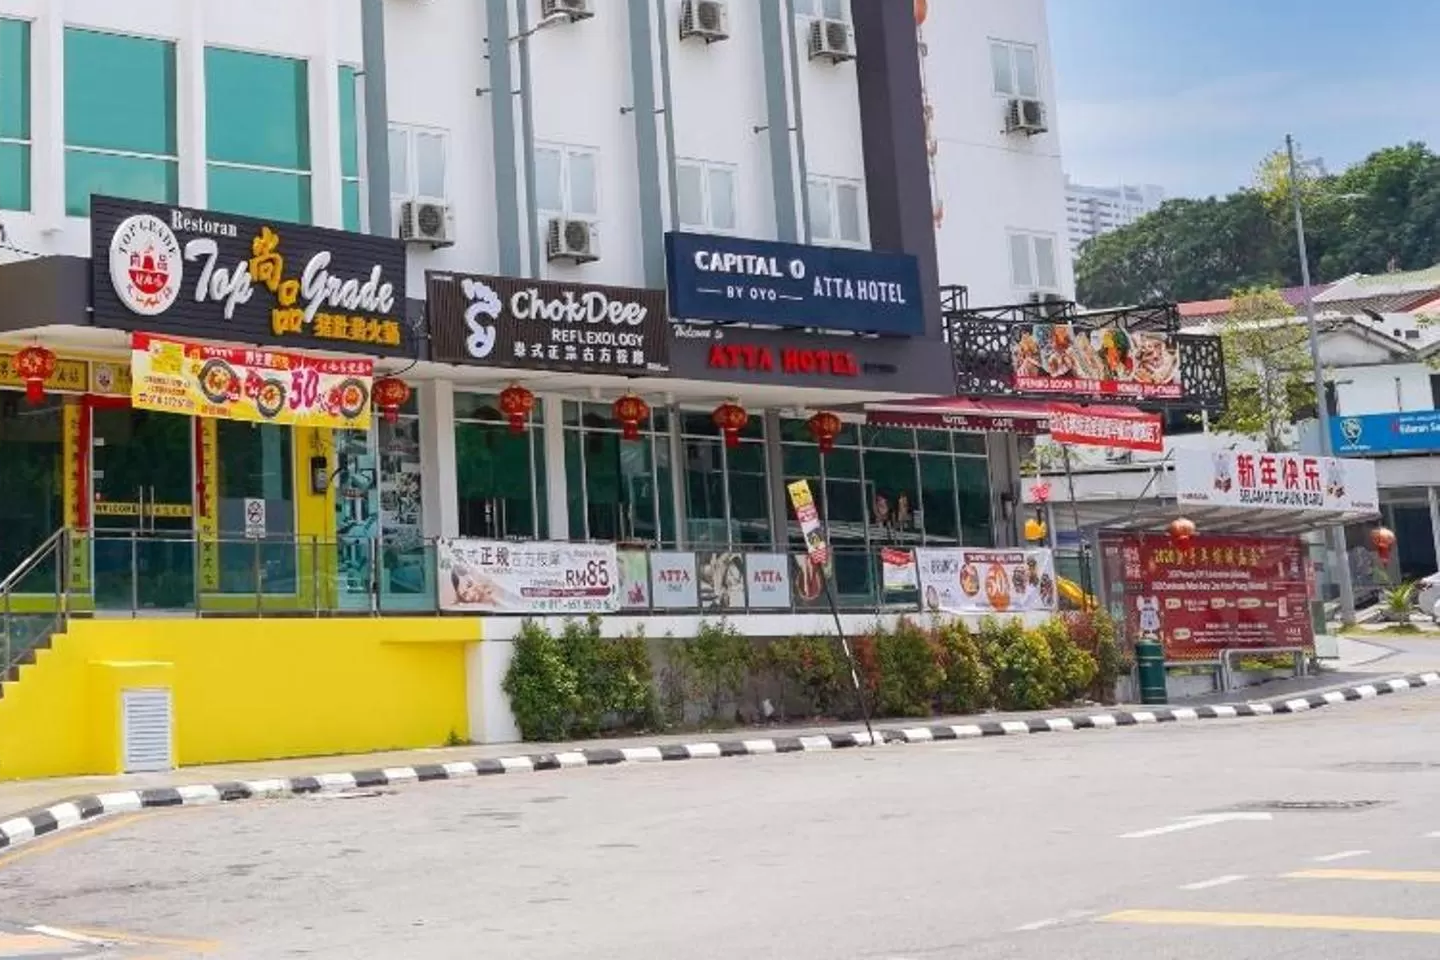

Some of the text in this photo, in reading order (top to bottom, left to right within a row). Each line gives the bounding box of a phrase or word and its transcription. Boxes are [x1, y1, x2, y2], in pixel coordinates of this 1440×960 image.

[171, 209, 238, 238] Restoran
[695, 250, 806, 280] CAPITAL O
[184, 238, 394, 324] Top Grade
[727, 285, 777, 301] BY OYO
[813, 276, 907, 304] ATTA HOTEL
[551, 327, 645, 347] REFLEXOLOGY
[709, 344, 774, 372] ATTA
[781, 346, 859, 377] HOTEL
[1236, 453, 1322, 492] 新年快乐
[658, 569, 690, 583] ATTA
[753, 569, 782, 583] ATTA
